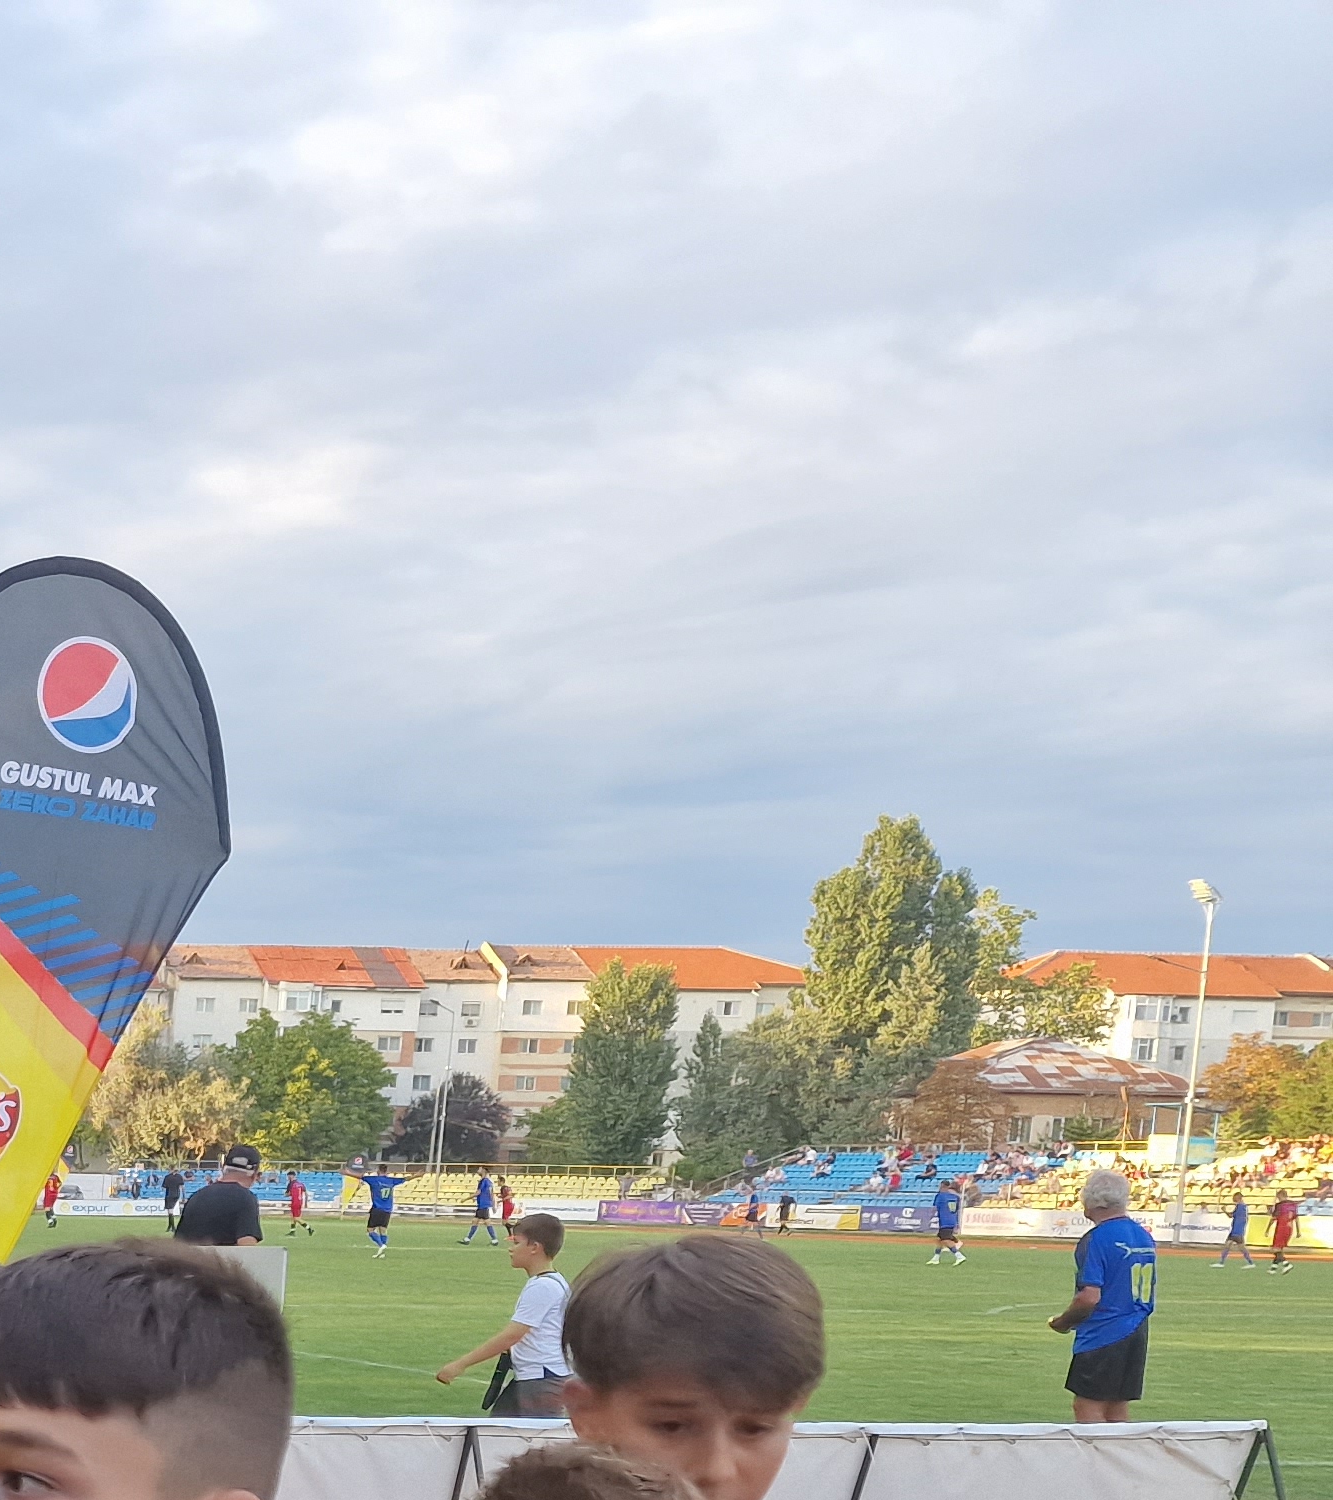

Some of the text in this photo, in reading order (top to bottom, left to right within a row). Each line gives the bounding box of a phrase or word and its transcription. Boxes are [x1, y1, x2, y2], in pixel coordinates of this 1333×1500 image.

[0, 761, 159, 807] GUSTUL MAX
[72, 1204, 166, 1214] expur expu
[1130, 1262, 1154, 1304] 11
